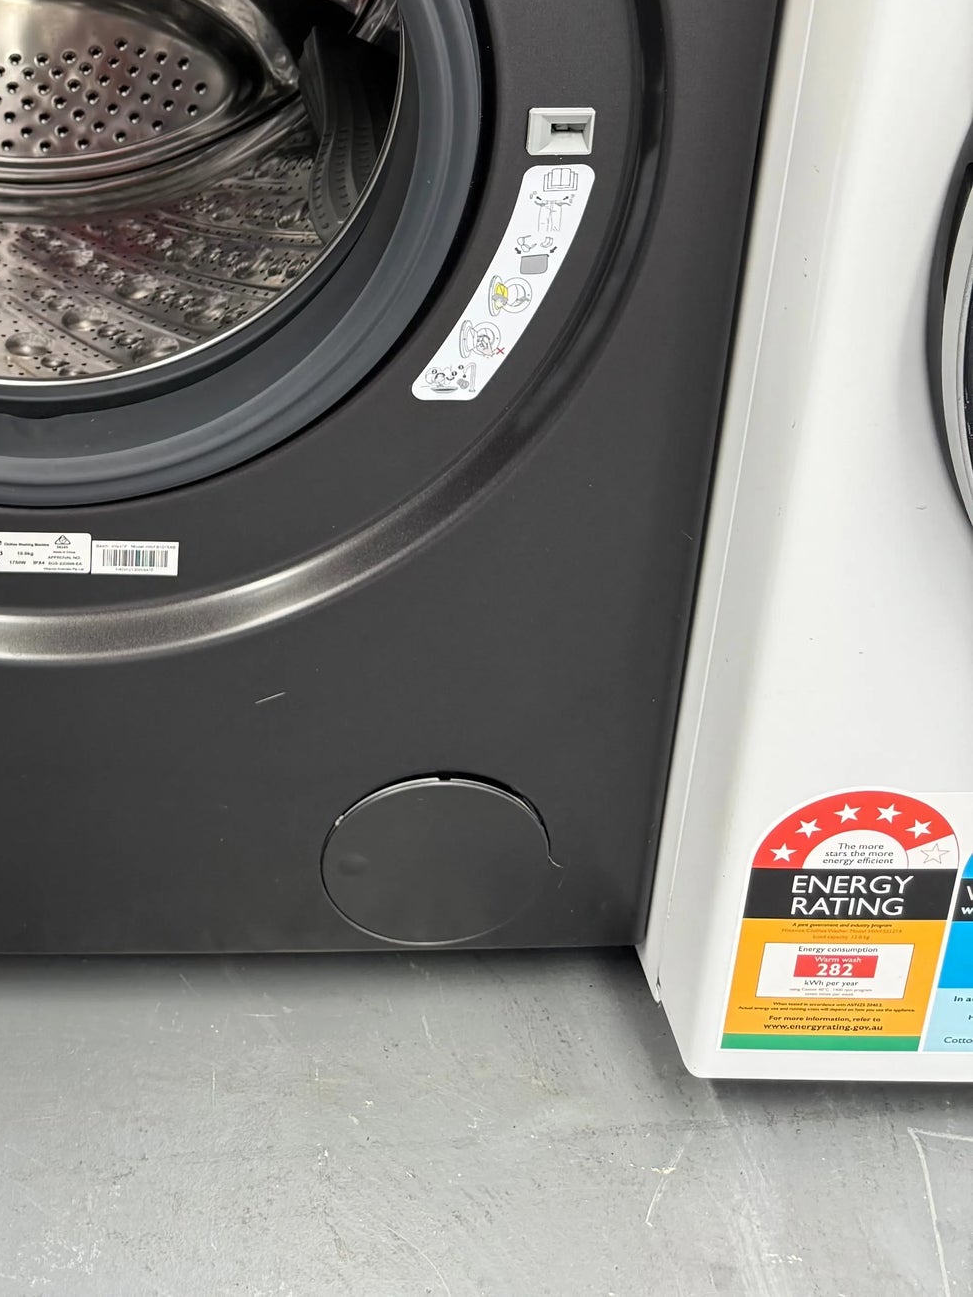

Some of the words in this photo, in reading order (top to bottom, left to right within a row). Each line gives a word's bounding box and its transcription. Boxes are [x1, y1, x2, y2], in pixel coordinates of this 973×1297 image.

[838, 842, 856, 850] The
[822, 858, 855, 866] energy
[791, 875, 914, 894] ENERGY
[790, 897, 905, 916] RATING
[798, 945, 826, 953] Energy
[815, 963, 854, 976] 282
[763, 1023, 883, 1031] www.energyrating.gov.au
